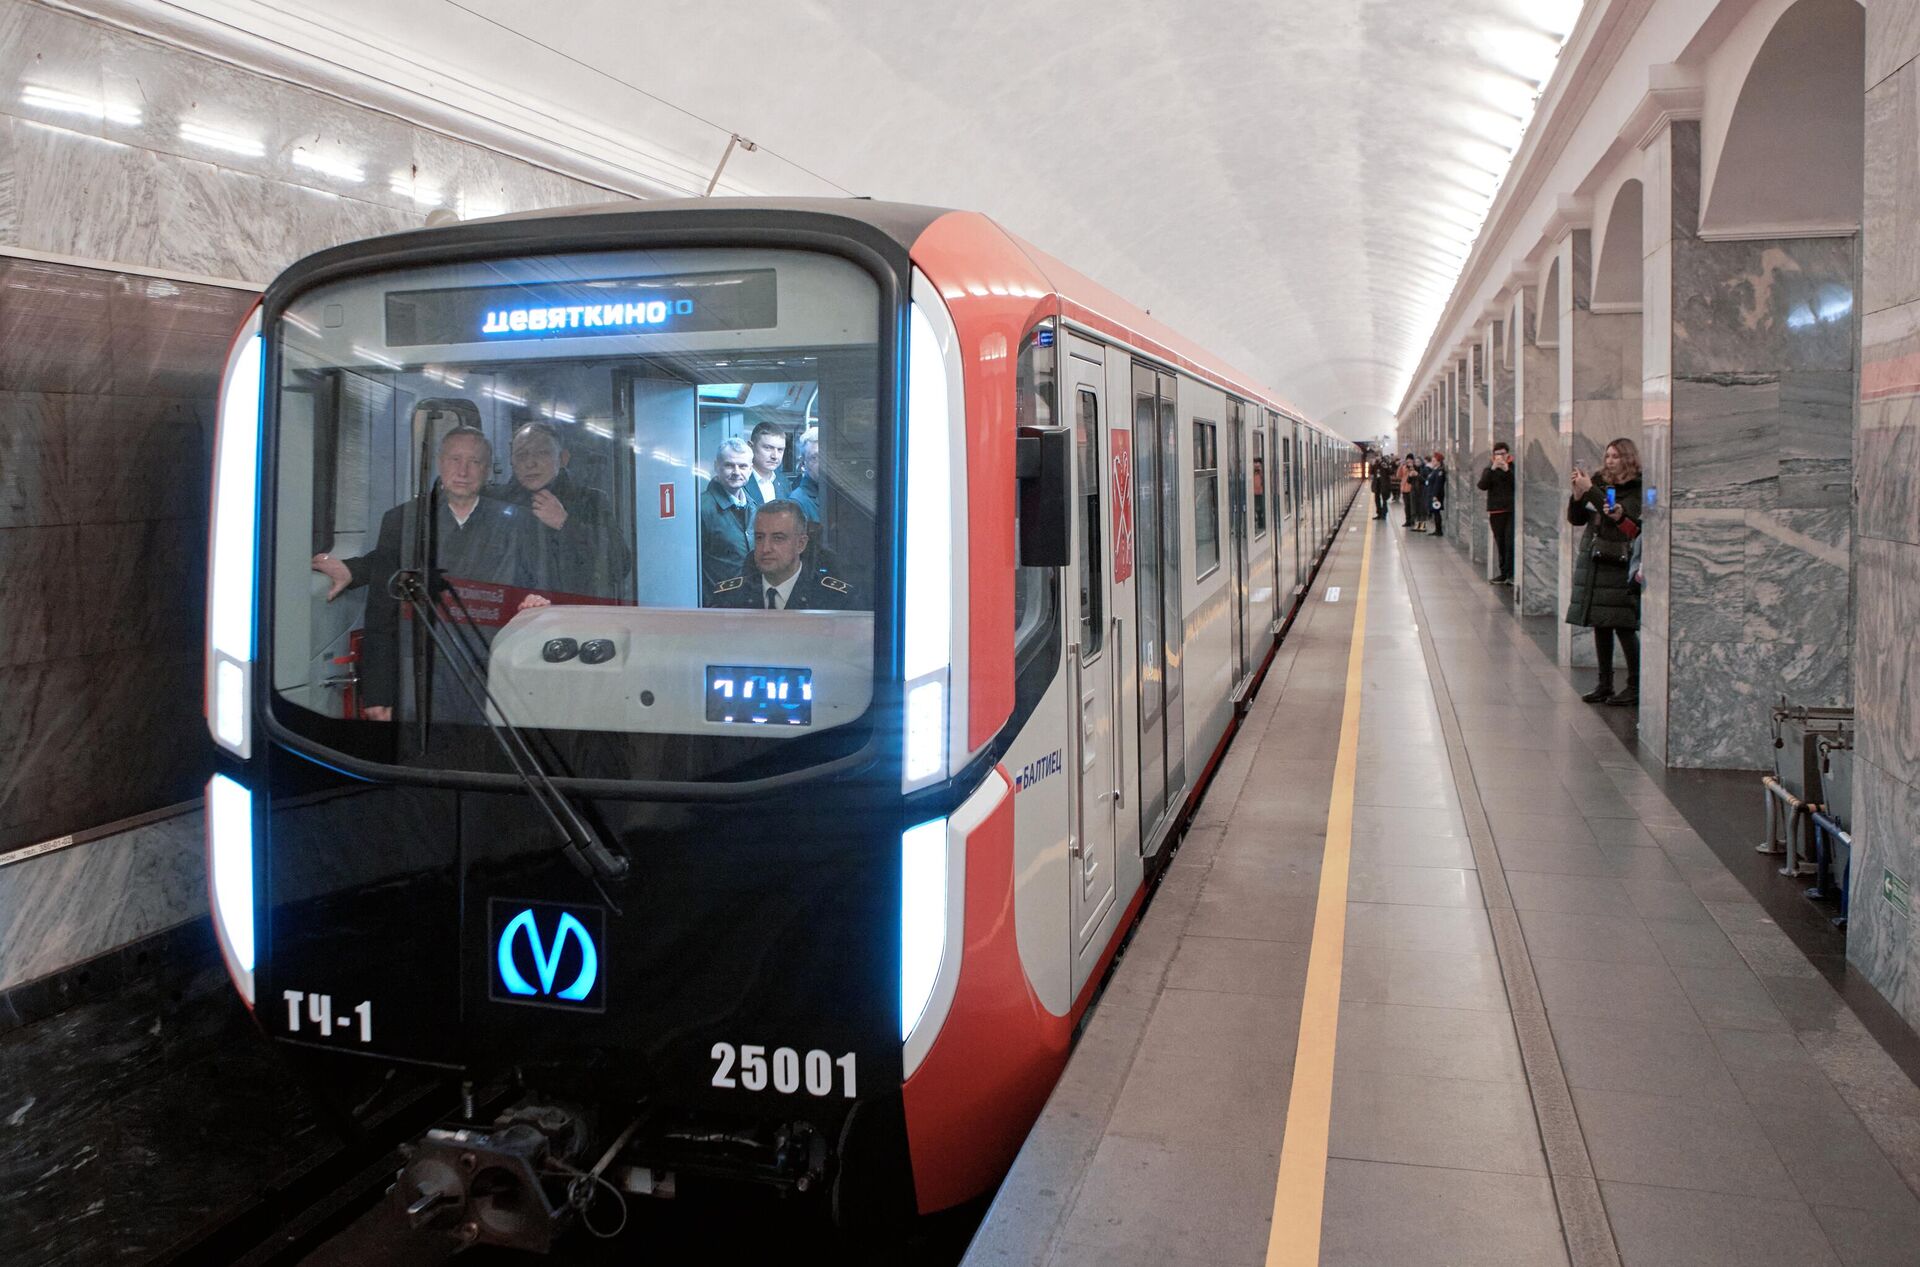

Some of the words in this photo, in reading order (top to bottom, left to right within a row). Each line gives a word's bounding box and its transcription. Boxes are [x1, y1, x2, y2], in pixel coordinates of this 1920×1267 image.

[1023, 748, 1062, 790] БАЛТИЕЦ
[283, 989, 372, 1042] ТЧ-1
[710, 1042, 856, 1098] 25001
